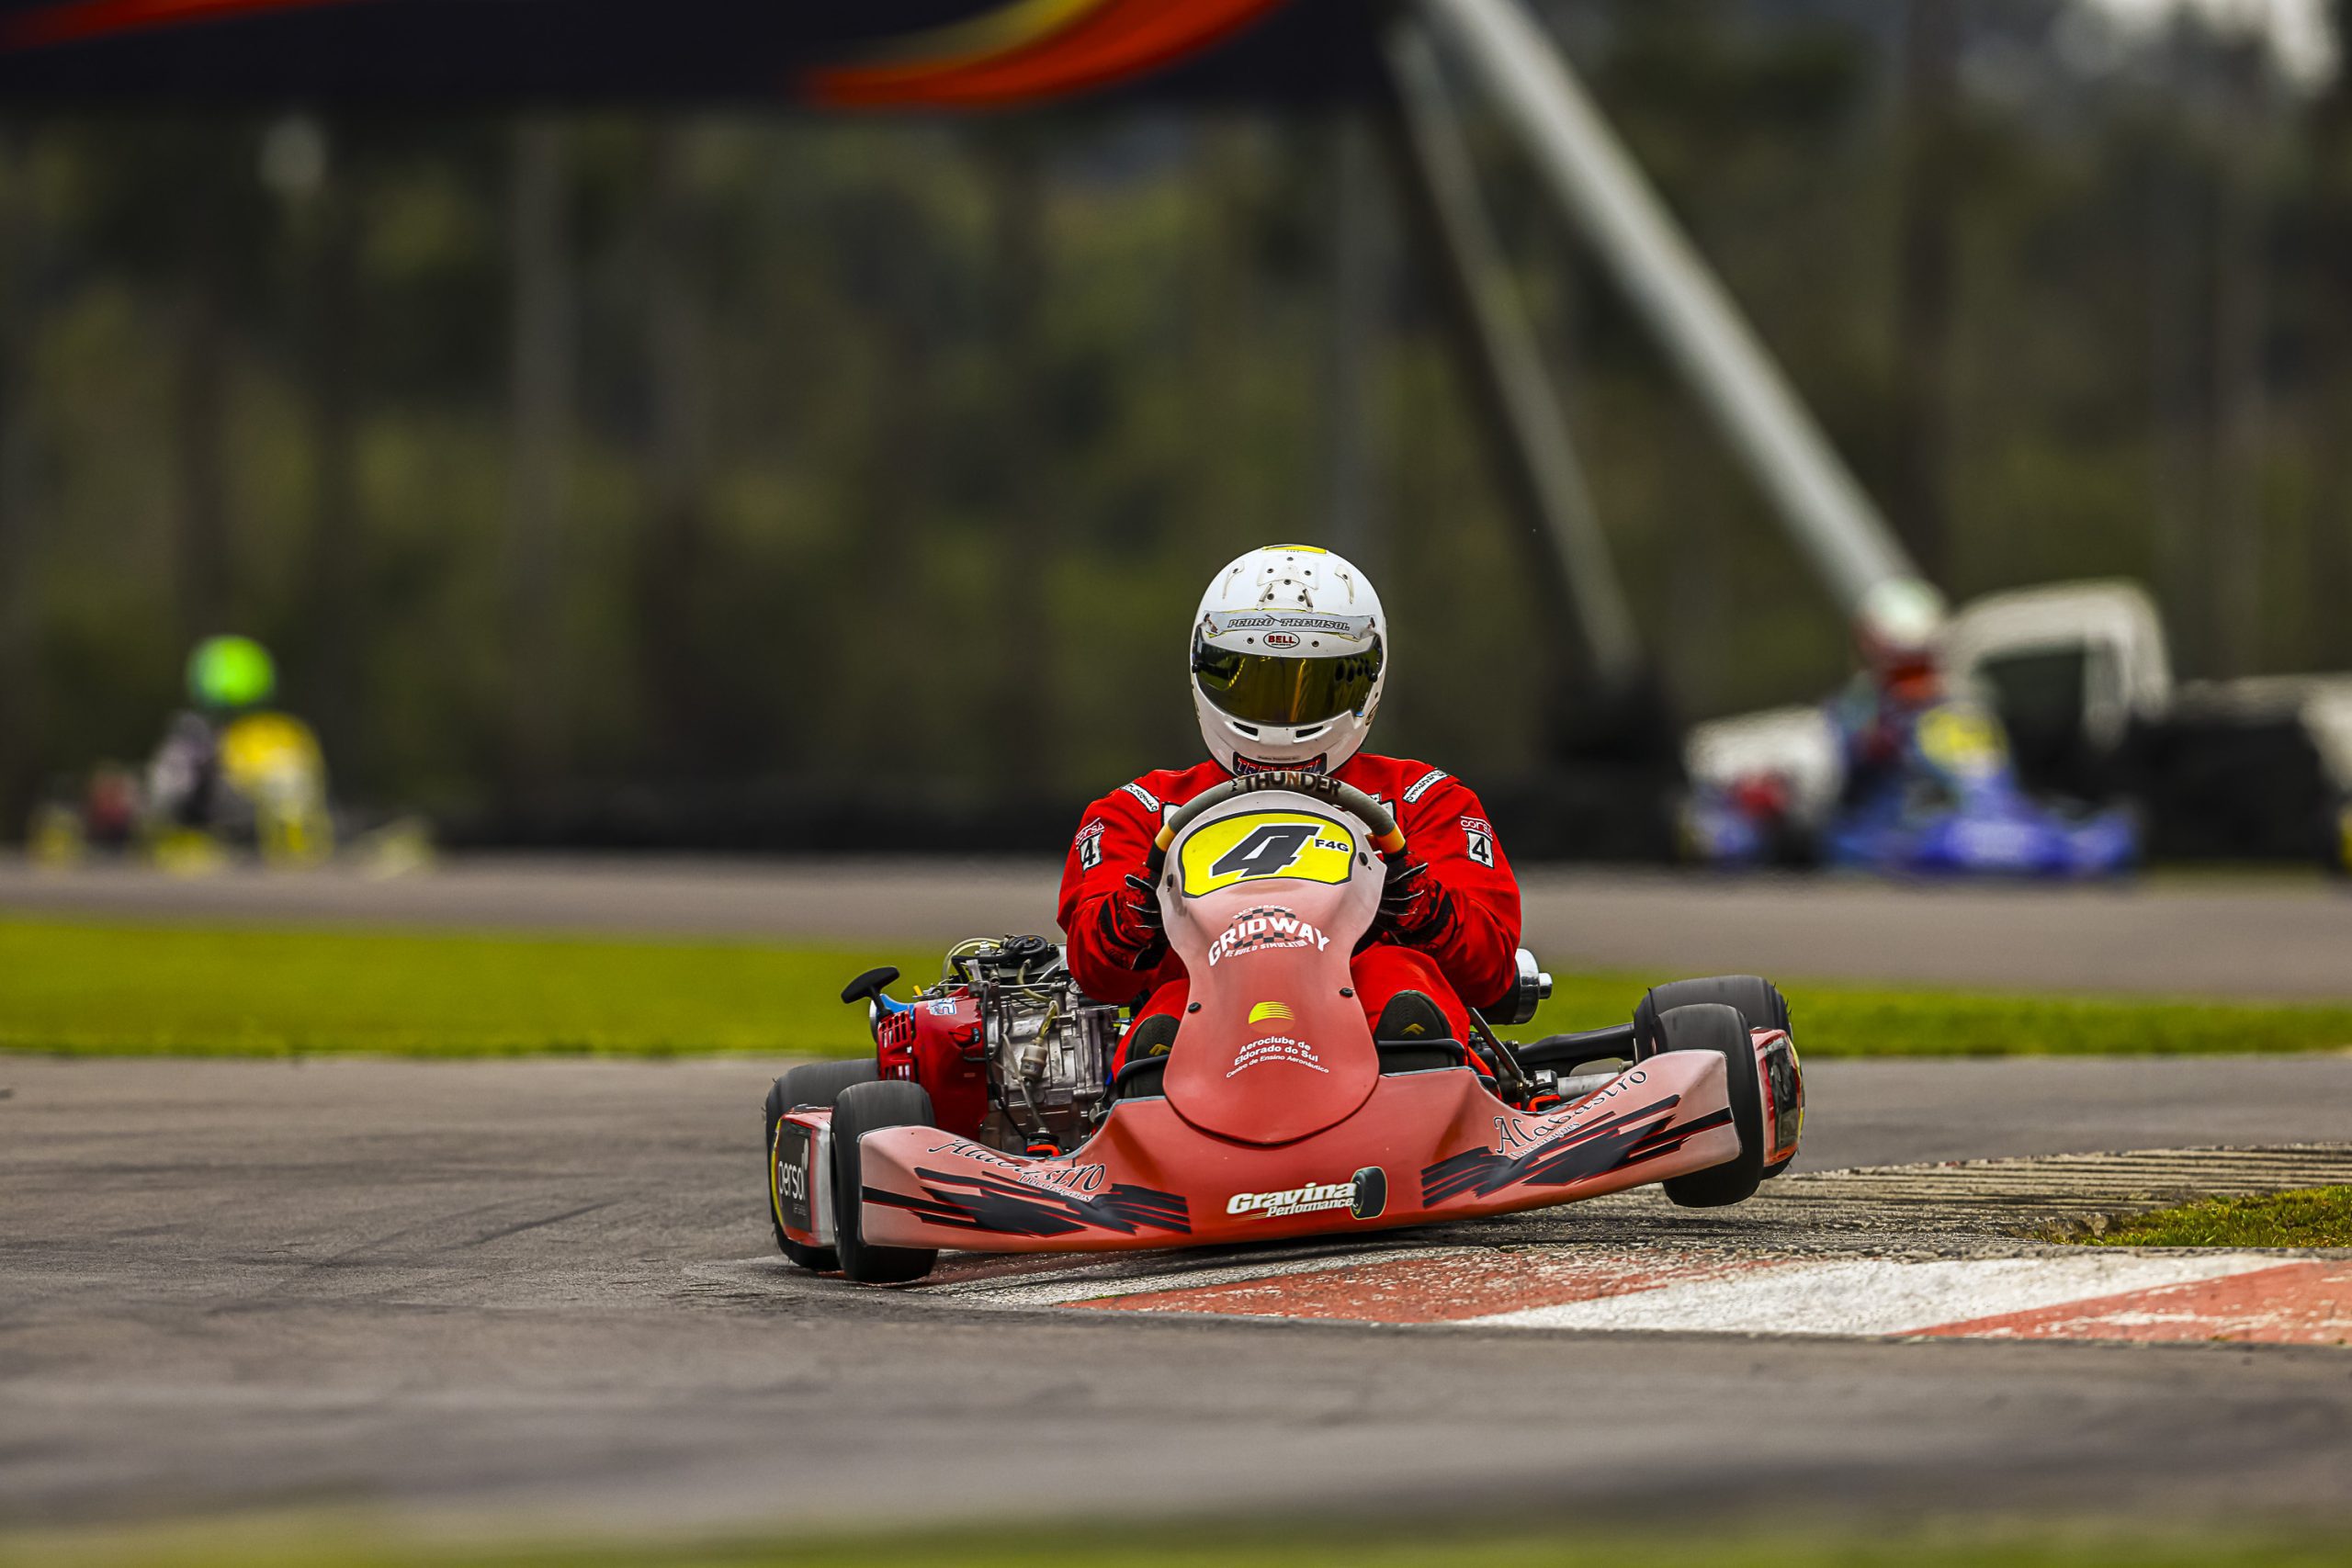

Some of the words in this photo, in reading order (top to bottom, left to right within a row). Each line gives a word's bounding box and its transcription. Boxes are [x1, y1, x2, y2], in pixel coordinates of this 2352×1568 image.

[1227, 617, 1275, 628] PEDRO
[1280, 618, 1351, 631] TREVISOL
[1268, 635, 1295, 645] BELL
[1244, 771, 1342, 797] THUNDER
[1082, 838, 1097, 865] 4
[1211, 824, 1323, 879] 4
[1314, 838, 1350, 852] F4G
[1471, 837, 1489, 863] 4
[1208, 917, 1330, 967] GRIDWAY
[1234, 1044, 1283, 1066] Eldorado
[1283, 1046, 1299, 1055] do
[1300, 1049, 1319, 1063] Sul
[1238, 1035, 1295, 1055] Aeroclube
[1297, 1041, 1311, 1051] de
[1226, 1063, 1249, 1078] Centro
[1249, 1057, 1260, 1066] de
[1227, 1181, 1358, 1214] Gravina
[1265, 1197, 1355, 1218] Performance
